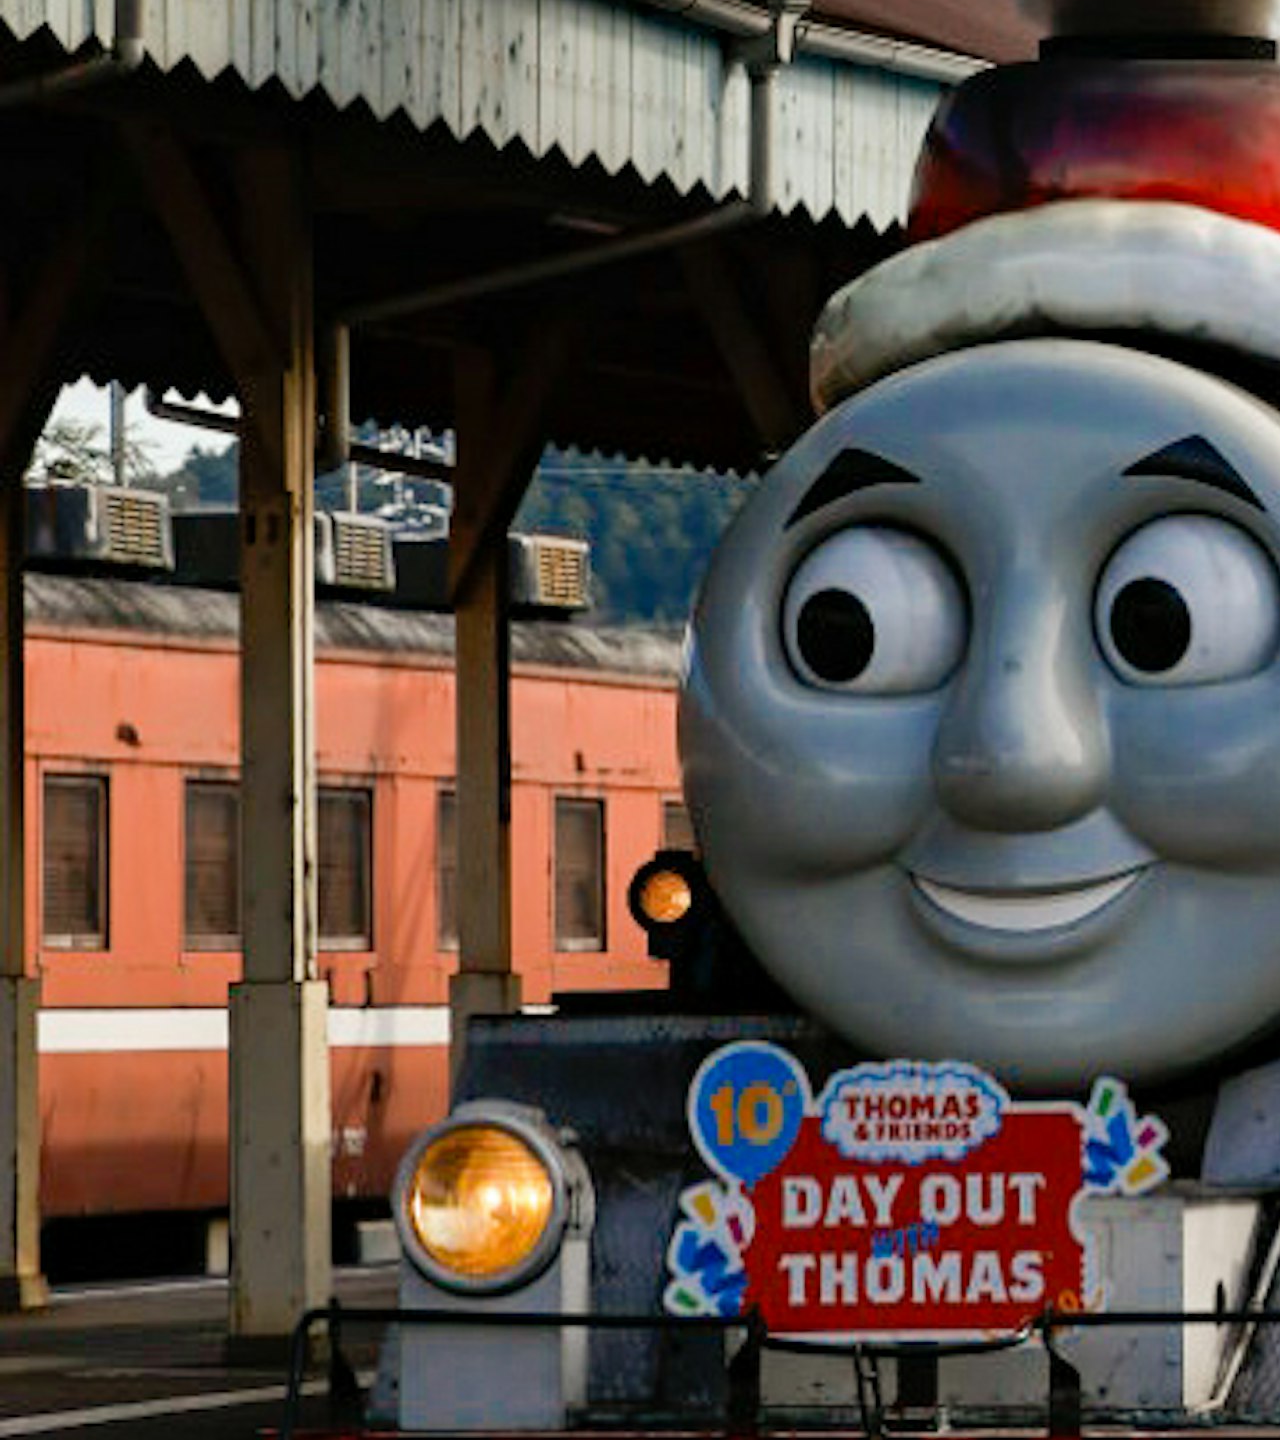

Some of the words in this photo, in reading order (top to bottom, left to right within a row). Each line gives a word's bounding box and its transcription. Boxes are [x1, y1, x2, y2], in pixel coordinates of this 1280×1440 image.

[844, 1094, 980, 1119] THOMAS
[856, 1123, 869, 1141] &
[875, 1123, 971, 1141] FRIENDS
[780, 1174, 904, 1228] DAY
[918, 1172, 1047, 1226] OUT
[778, 1250, 1046, 1307] THOMAS
